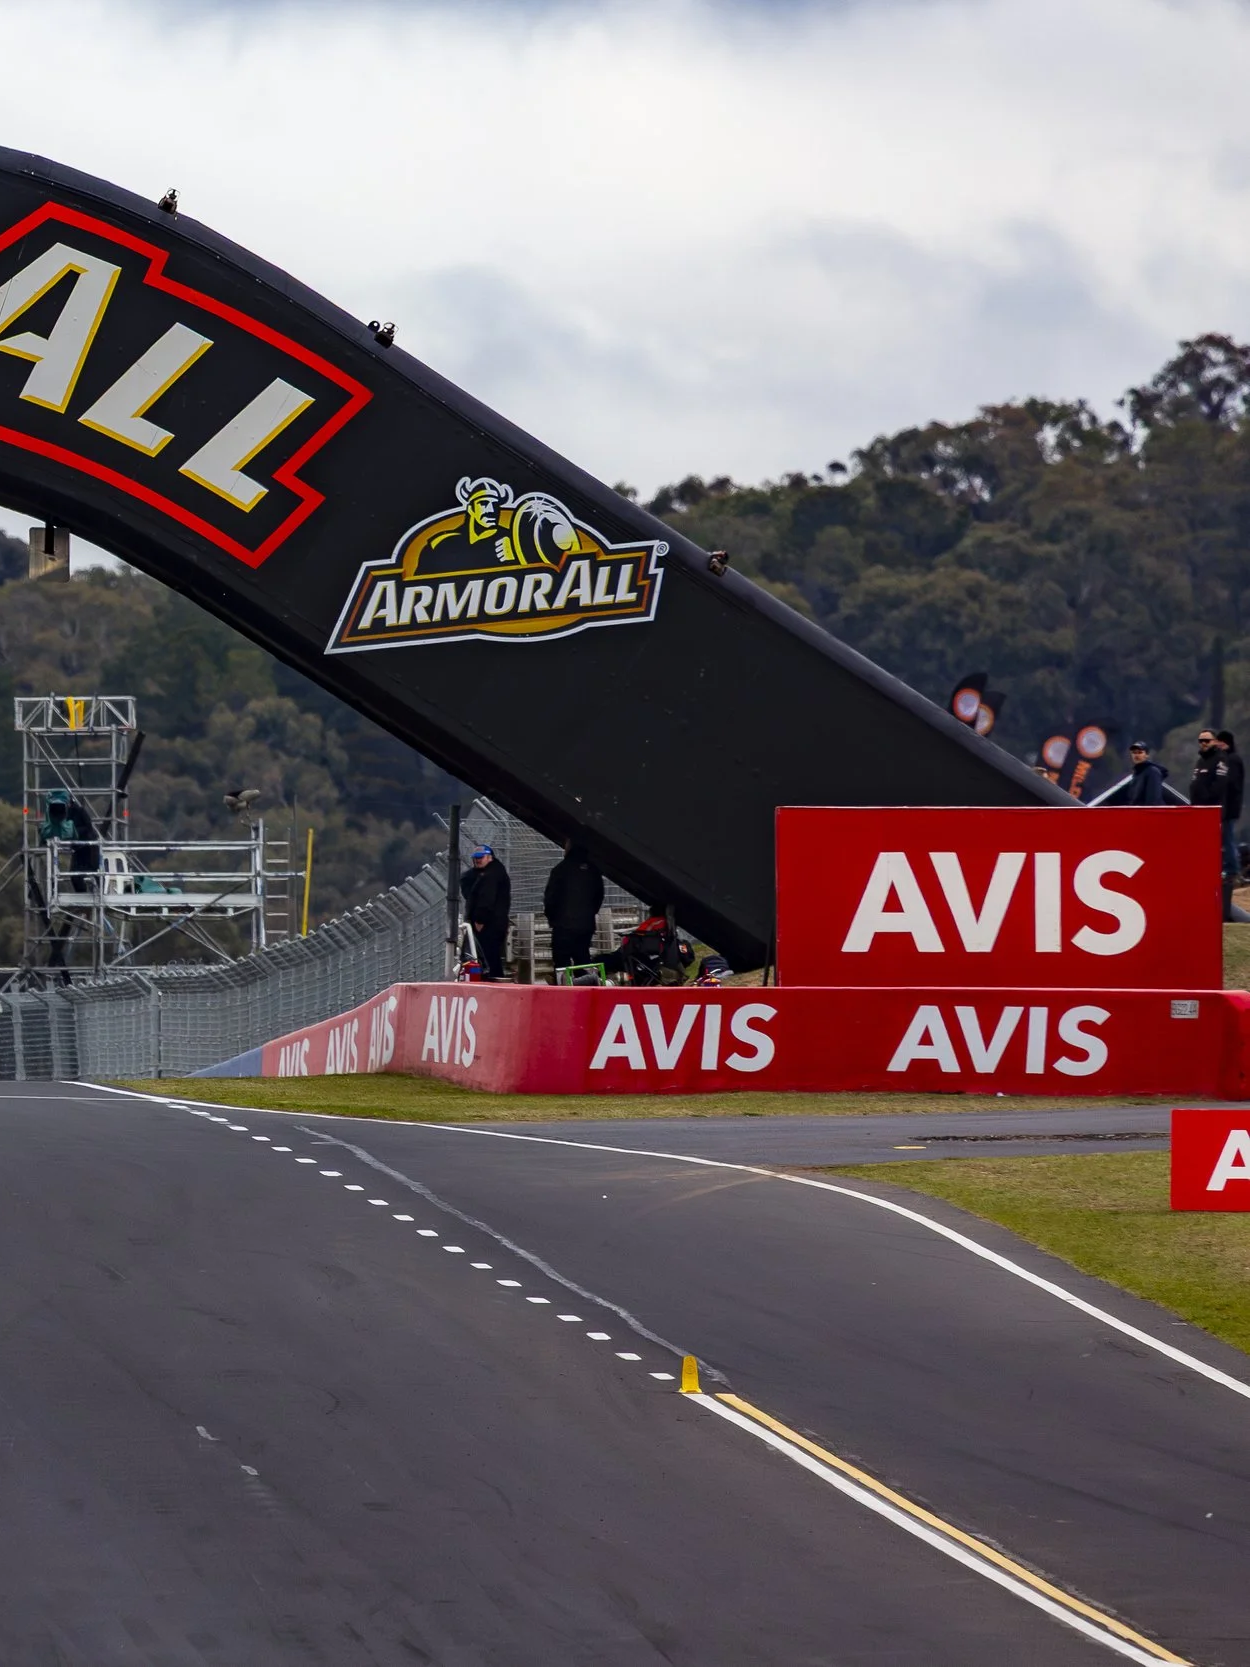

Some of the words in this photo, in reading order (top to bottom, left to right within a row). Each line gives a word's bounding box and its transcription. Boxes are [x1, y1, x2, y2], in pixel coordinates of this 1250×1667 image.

[358, 560, 638, 630] ARMORALL
[841, 850, 1147, 956] AVIS
[325, 1018, 359, 1075] AVIS
[367, 996, 398, 1073] AVIS
[421, 996, 478, 1068] AVIS
[589, 1003, 778, 1072] AVIS
[886, 1005, 1111, 1077] AVIS
